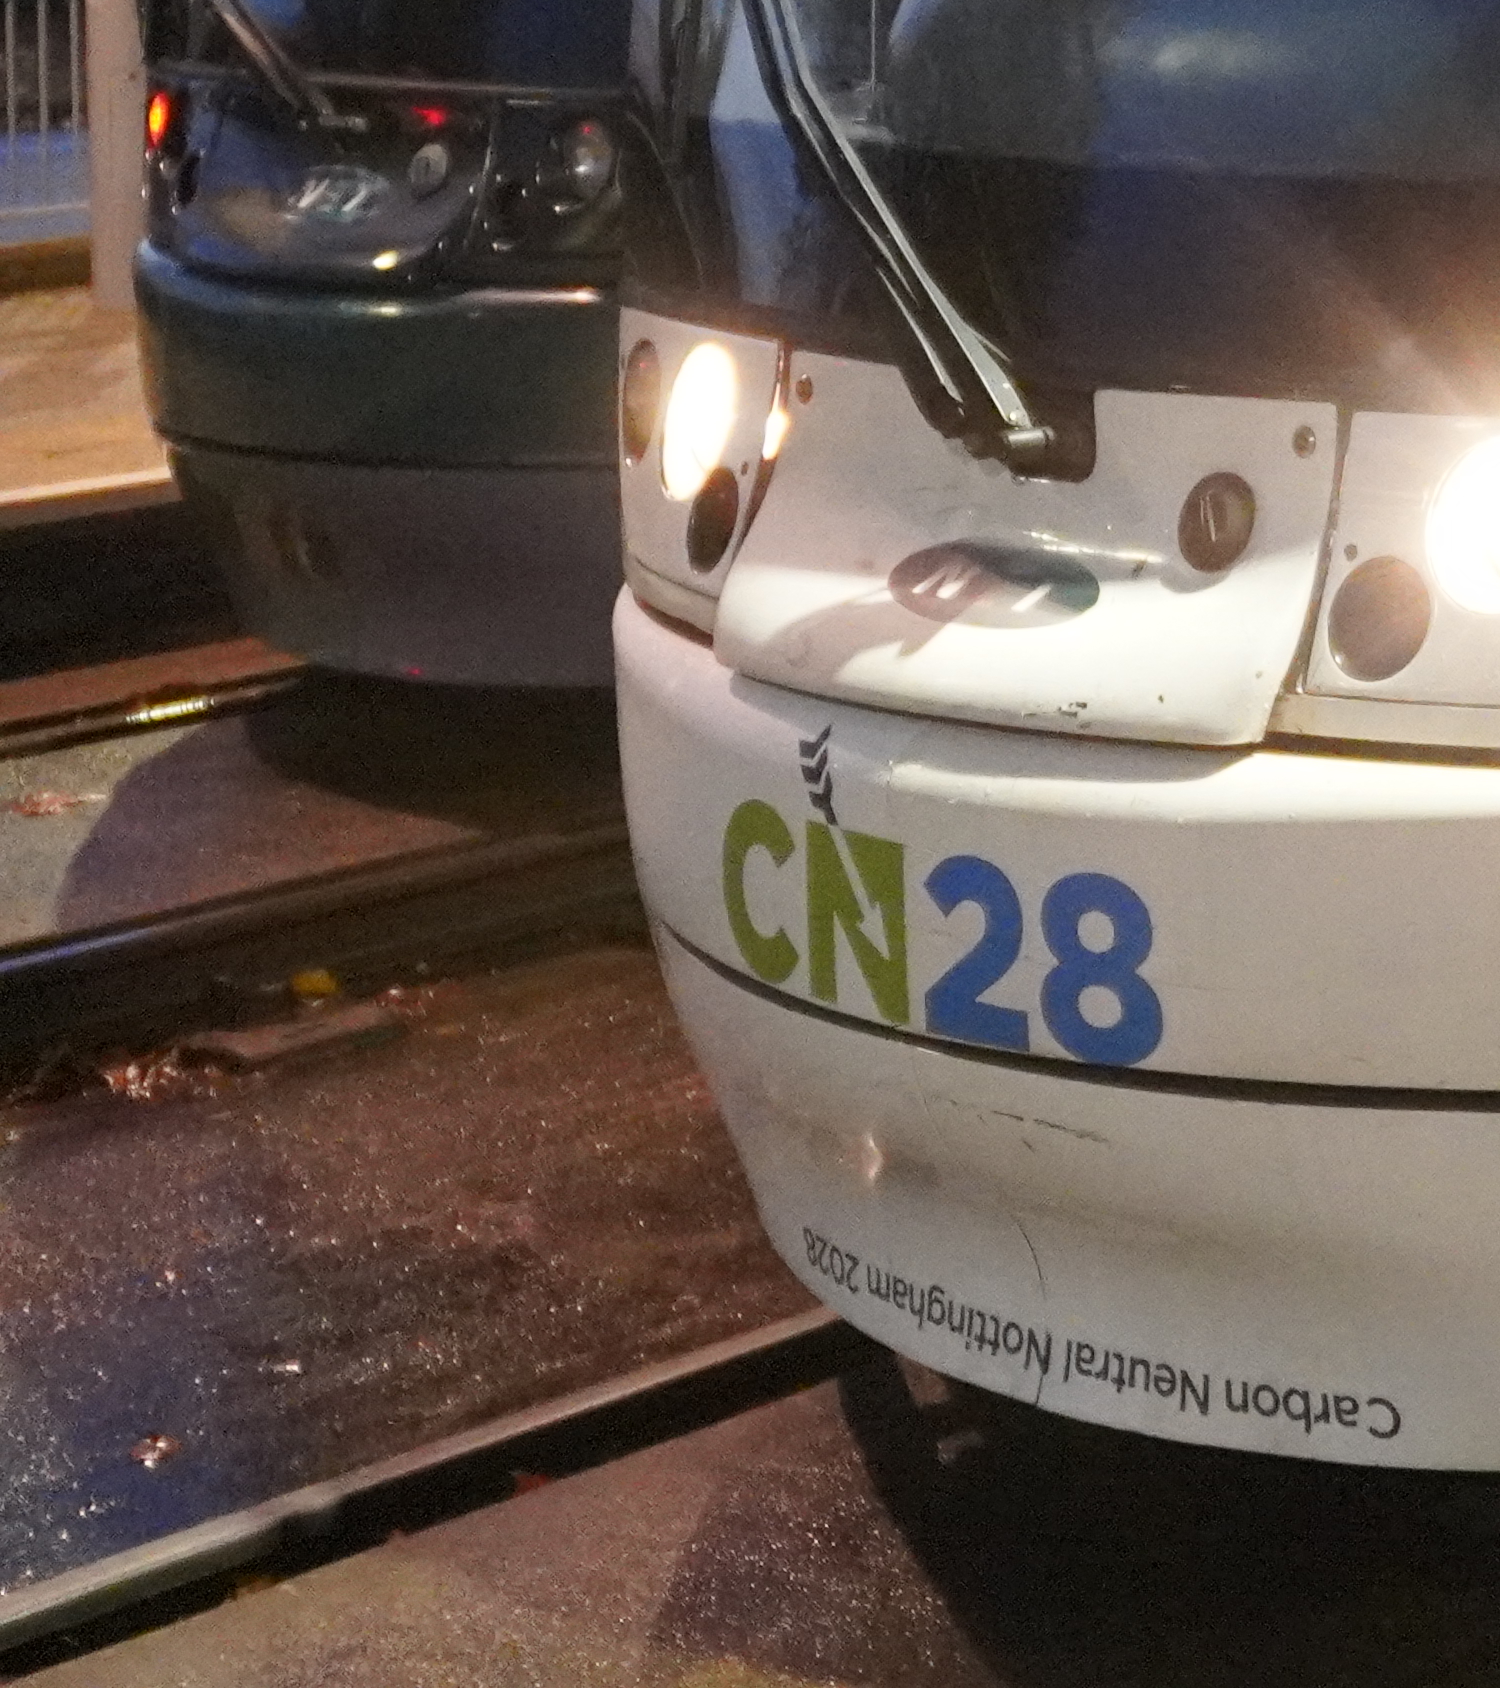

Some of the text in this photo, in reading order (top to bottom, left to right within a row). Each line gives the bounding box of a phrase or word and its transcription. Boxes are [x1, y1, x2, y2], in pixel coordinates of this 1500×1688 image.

[802, 1226, 1402, 1439] Carbon Neutral Nottingham 2028
